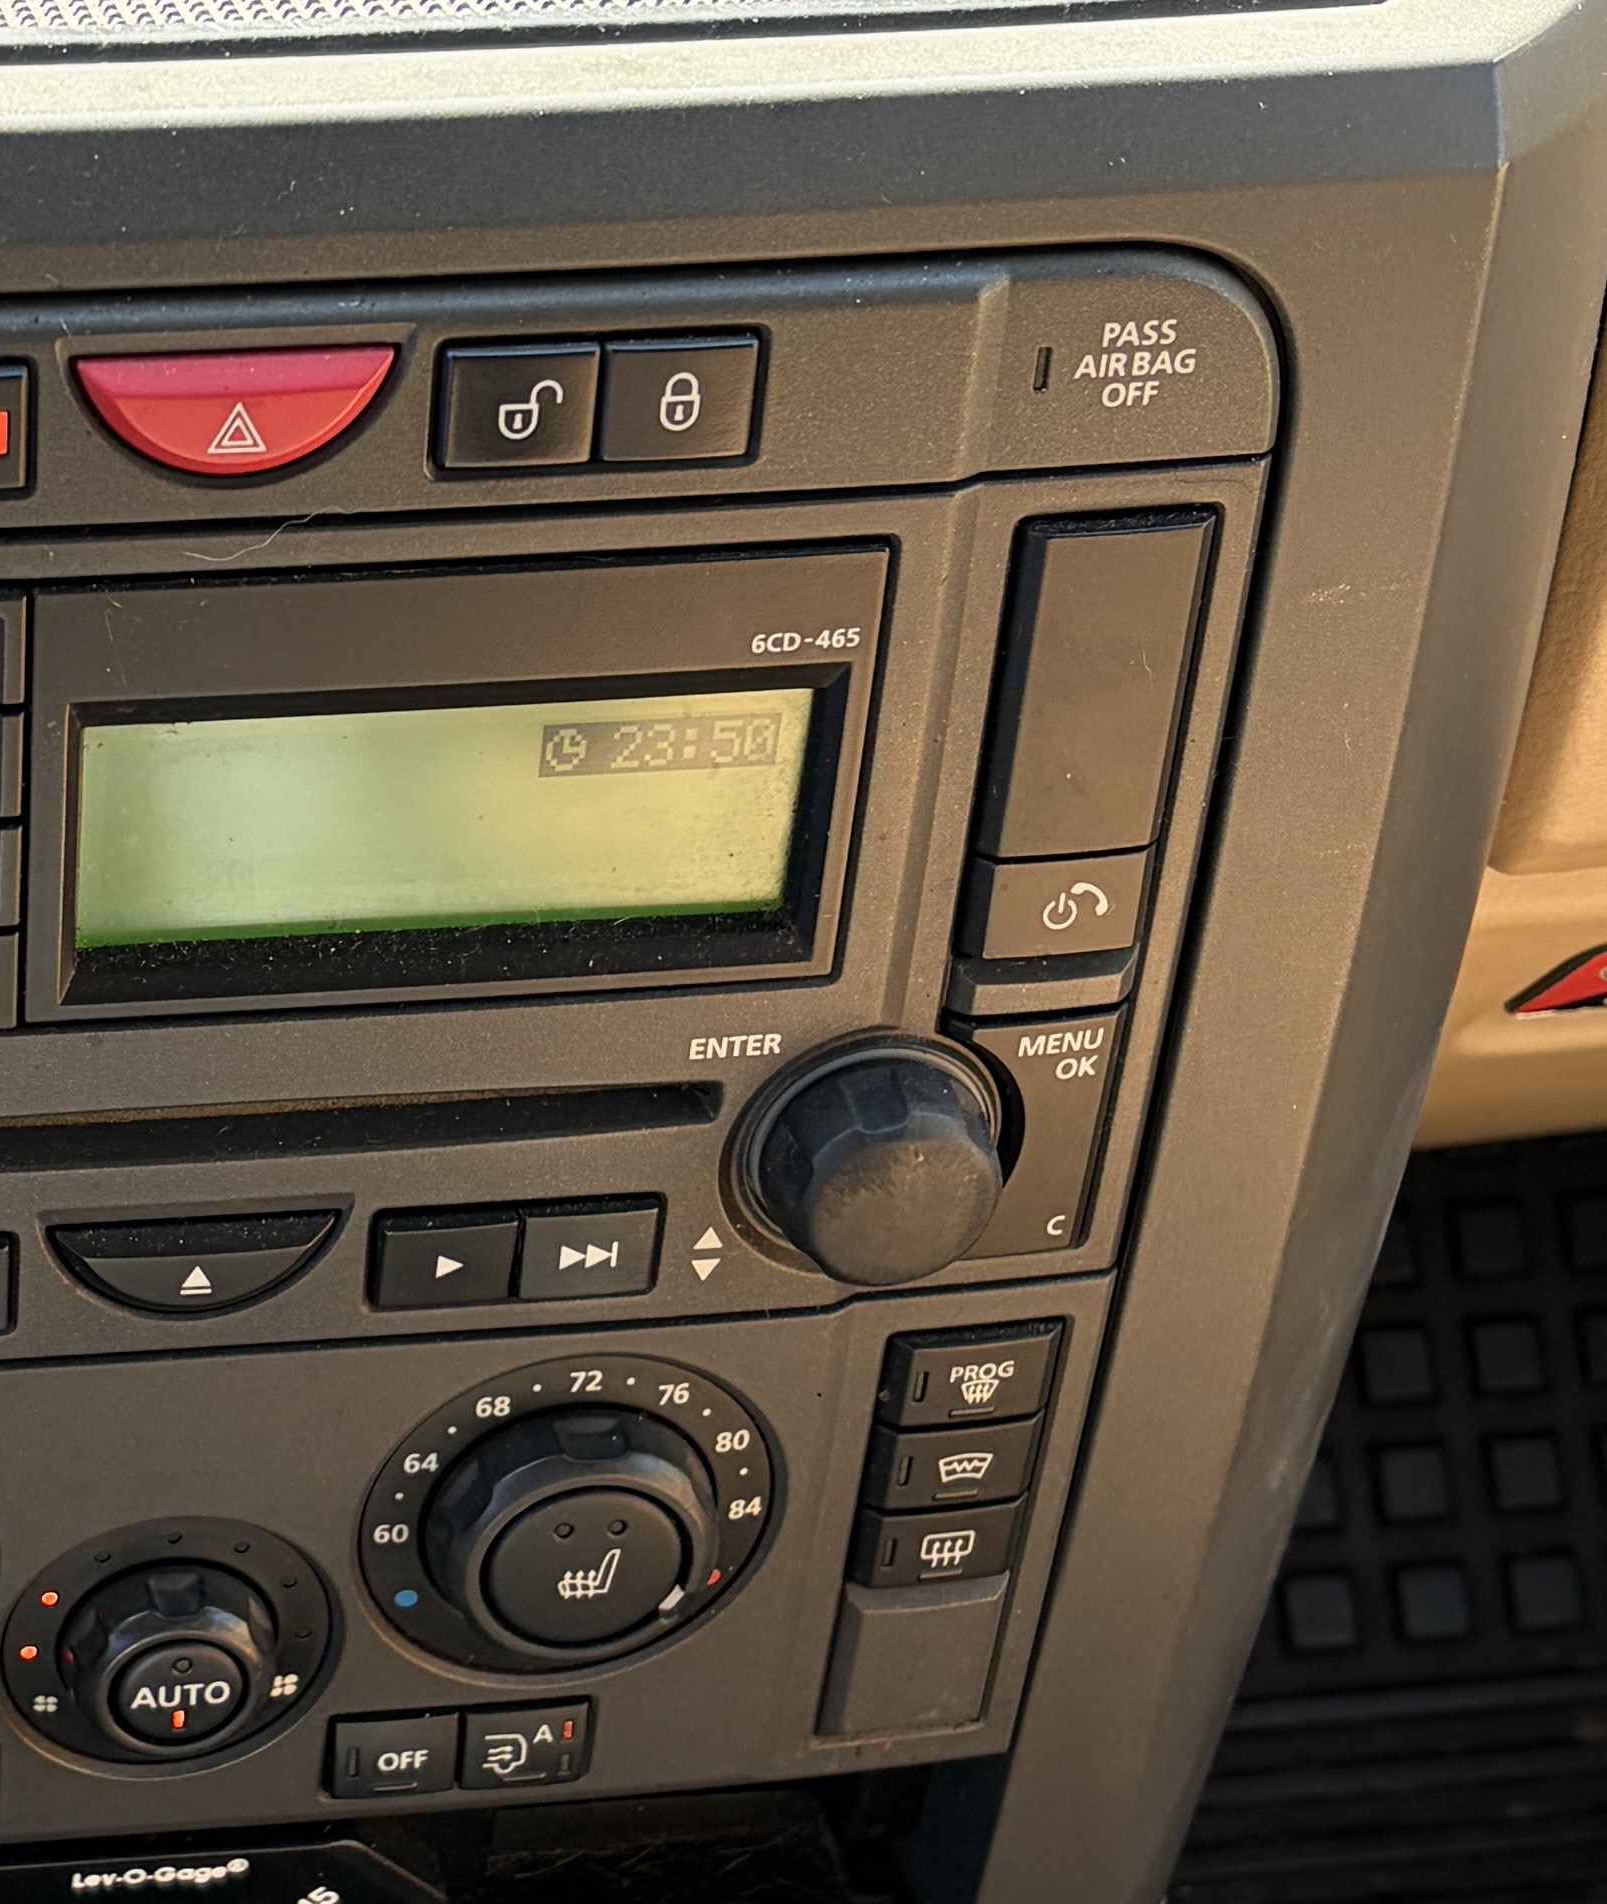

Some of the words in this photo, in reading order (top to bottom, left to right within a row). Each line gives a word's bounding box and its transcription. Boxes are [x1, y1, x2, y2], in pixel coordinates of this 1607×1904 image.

[1102, 319, 1177, 348] PASS
[1102, 381, 1159, 407] OFF
[751, 628, 861, 653] 6CD-465
[610, 718, 778, 769] 23:50
[689, 1033, 782, 1060] ENTER
[1018, 1028, 1104, 1058] MENU
[1055, 1056, 1098, 1080] OK
[1046, 1215, 1066, 1236] C
[569, 1370, 603, 1393] 72
[950, 1360, 1015, 1383] PROG
[658, 1382, 690, 1406] 76
[475, 1396, 511, 1418] 68
[715, 1429, 750, 1453] 80
[403, 1452, 439, 1474] 64
[728, 1496, 762, 1520] 84
[373, 1524, 409, 1544] 60
[130, 1681, 230, 1710] AUTO
[377, 1749, 428, 1771] OFF
